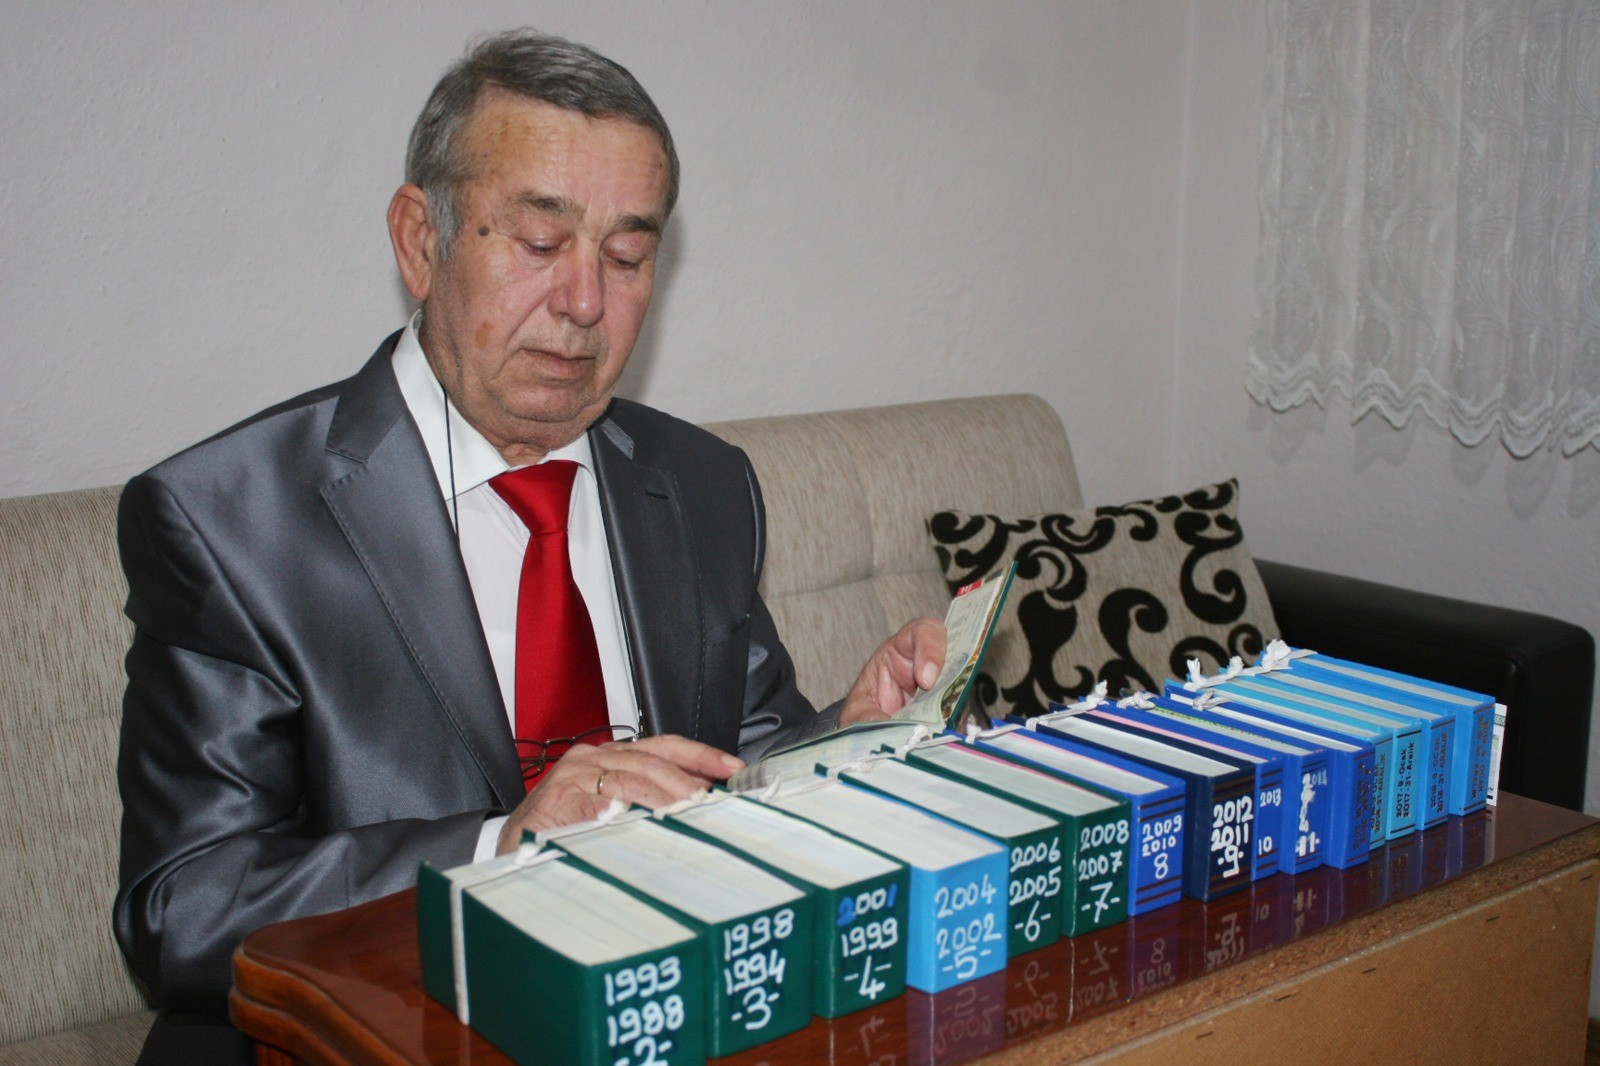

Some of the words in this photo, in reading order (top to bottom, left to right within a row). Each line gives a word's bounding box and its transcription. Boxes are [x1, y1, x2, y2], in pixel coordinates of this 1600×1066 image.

[1212, 796, 1254, 827] 2012
[1259, 788, 1283, 807] 2013
[1080, 820, 1130, 851] 2008
[1142, 815, 1182, 843] 2009
[1211, 823, 1250, 851] 2011
[1258, 836, 1273, 855] 10
[1009, 837, 1061, 873] 2006
[1142, 836, 1177, 857] 2010
[1078, 851, 1123, 881] 2007
[1154, 852, 1168, 879] 8
[934, 873, 997, 919] 2004
[1009, 866, 1062, 906] 2005
[723, 908, 795, 961] 1998
[841, 918, 899, 957] 1999
[936, 912, 1002, 959] 2002
[604, 955, 682, 1006] 1993
[723, 948, 787, 996] 1994
[607, 994, 685, 1047] 1988
